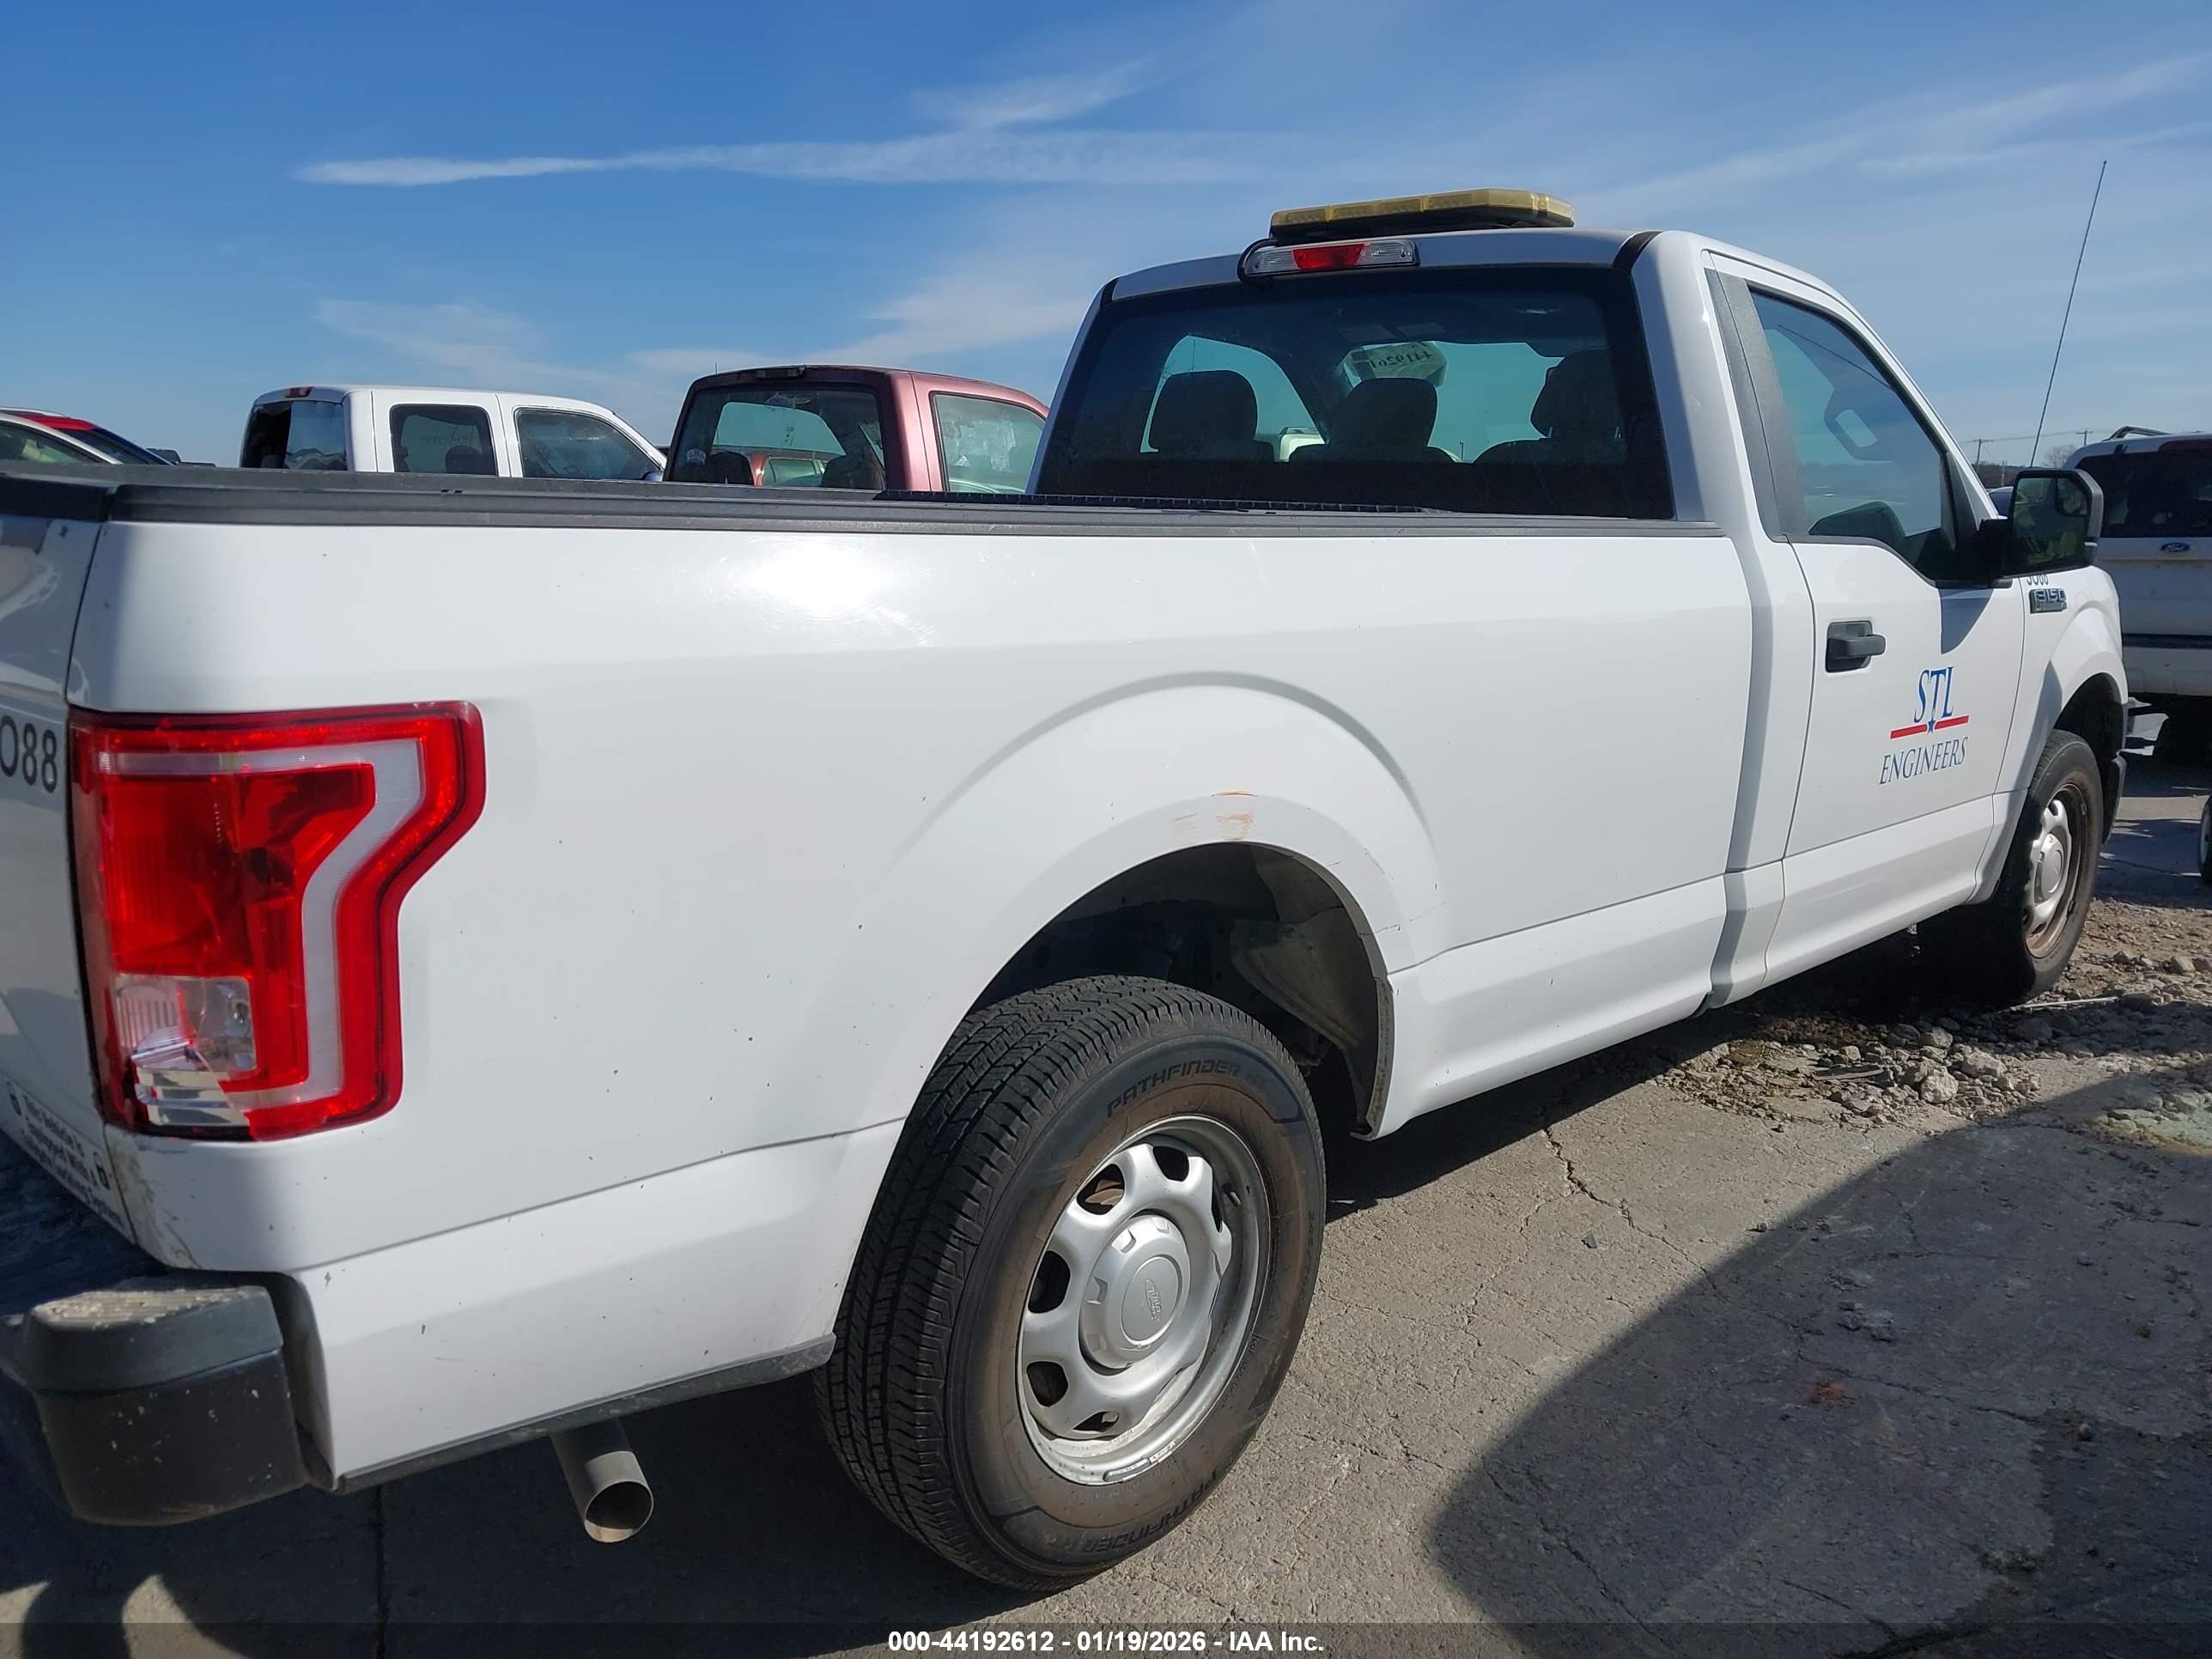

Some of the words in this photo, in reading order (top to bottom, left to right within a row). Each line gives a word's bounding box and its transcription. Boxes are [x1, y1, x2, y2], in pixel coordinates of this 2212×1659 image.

[1913, 666, 1954, 723] STL
[1879, 737, 1968, 785] ENGINEERS
[1106, 1059, 1241, 1118] PATHFINDER
